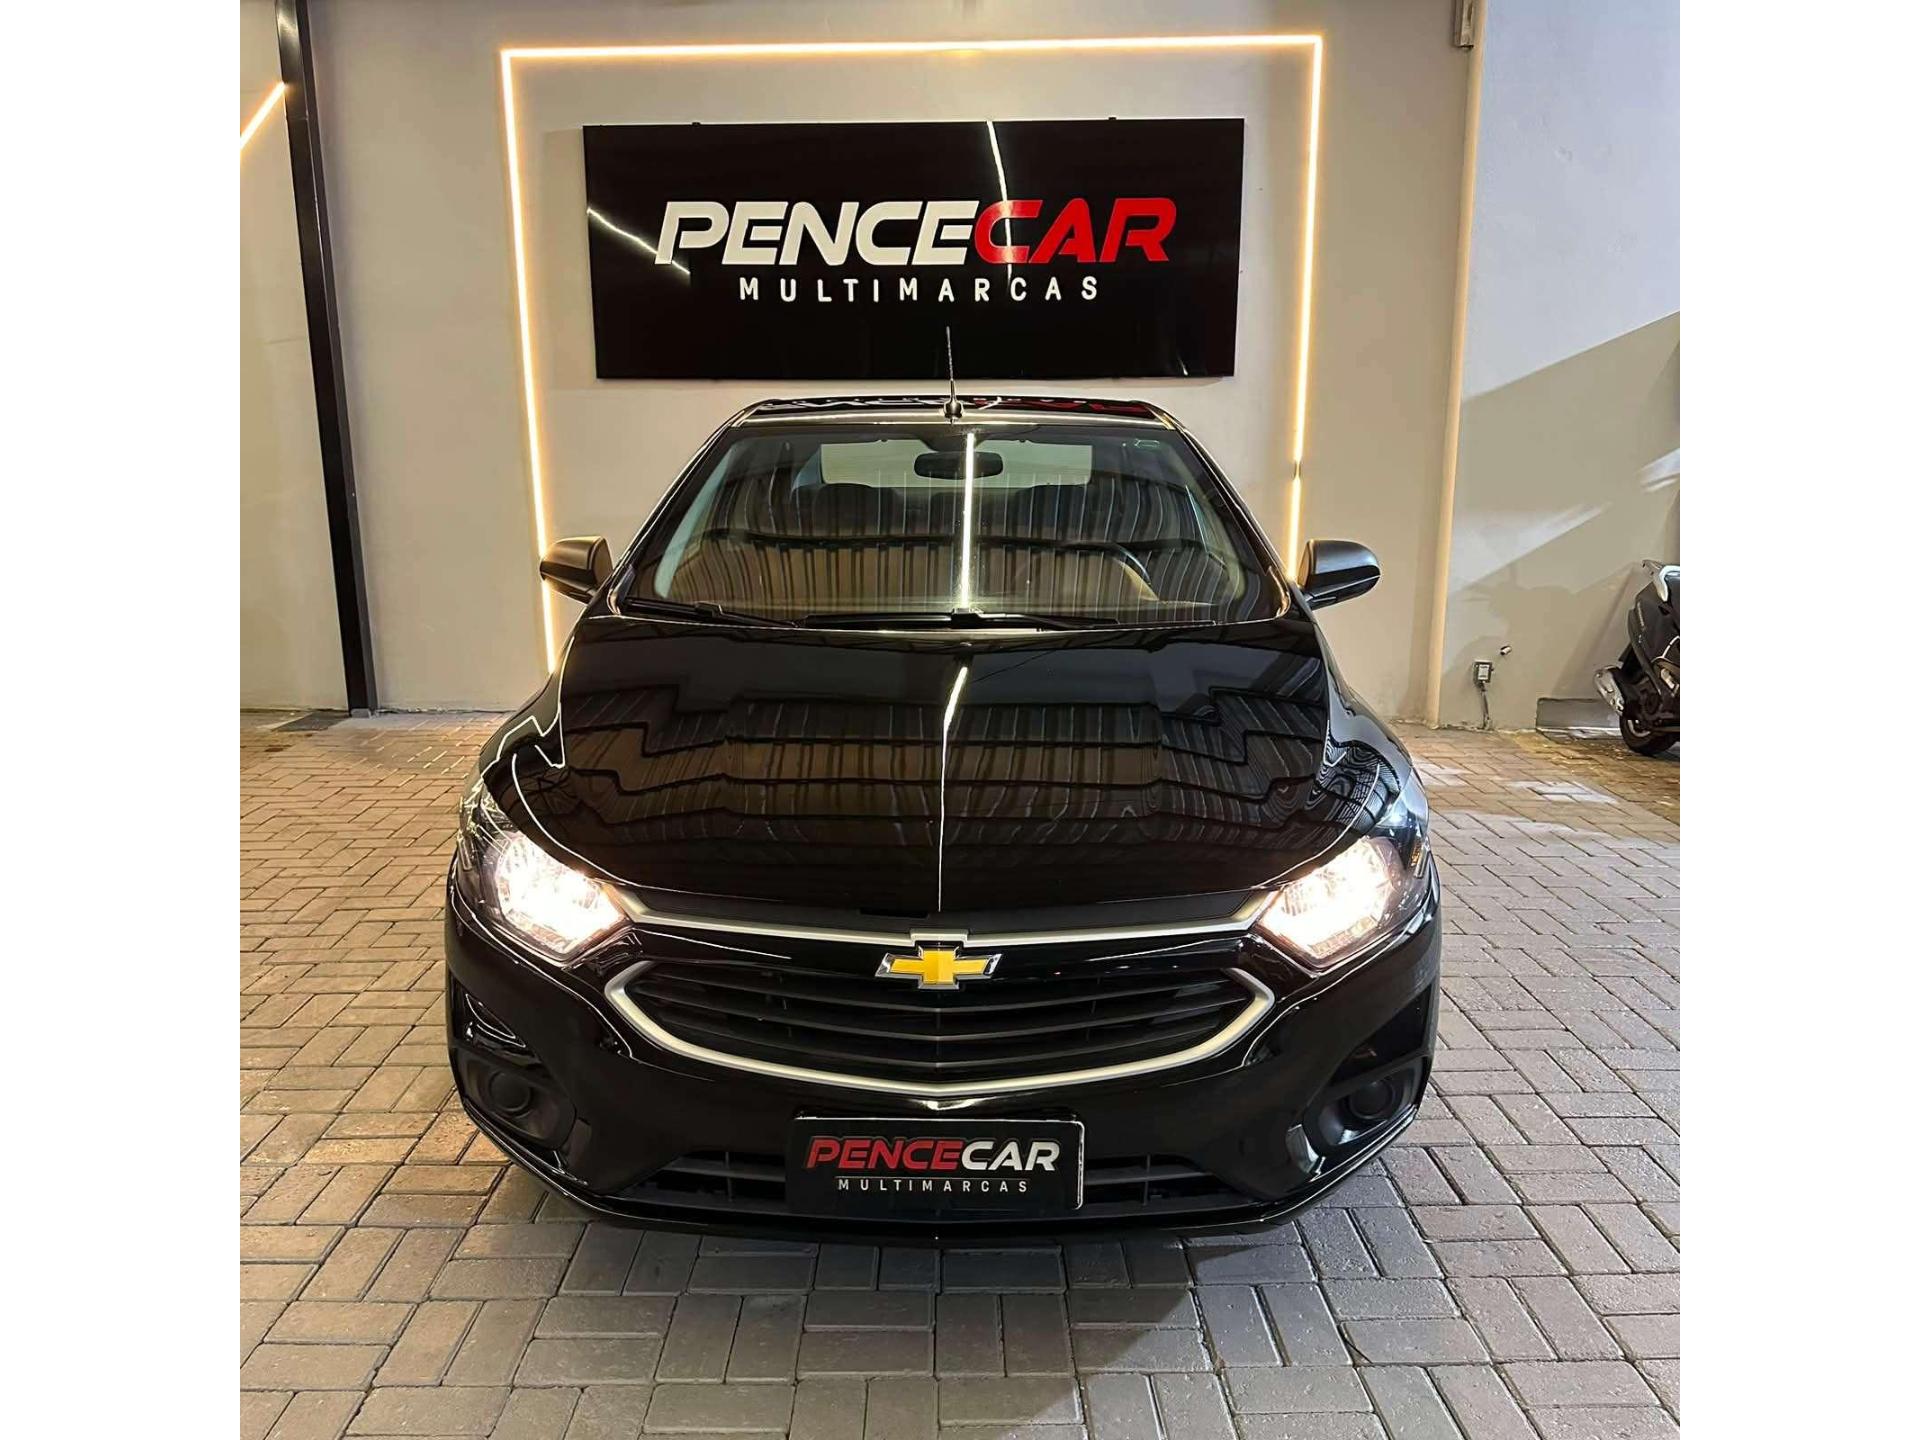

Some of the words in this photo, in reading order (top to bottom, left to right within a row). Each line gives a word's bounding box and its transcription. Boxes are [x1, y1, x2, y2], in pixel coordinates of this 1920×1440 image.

[654, 198, 1177, 265] PENCECAR
[739, 276, 1098, 302] MULTIMARCAS
[806, 1138, 1060, 1171] PENCECAR
[837, 1179, 1027, 1193] MULTIMARCAS
